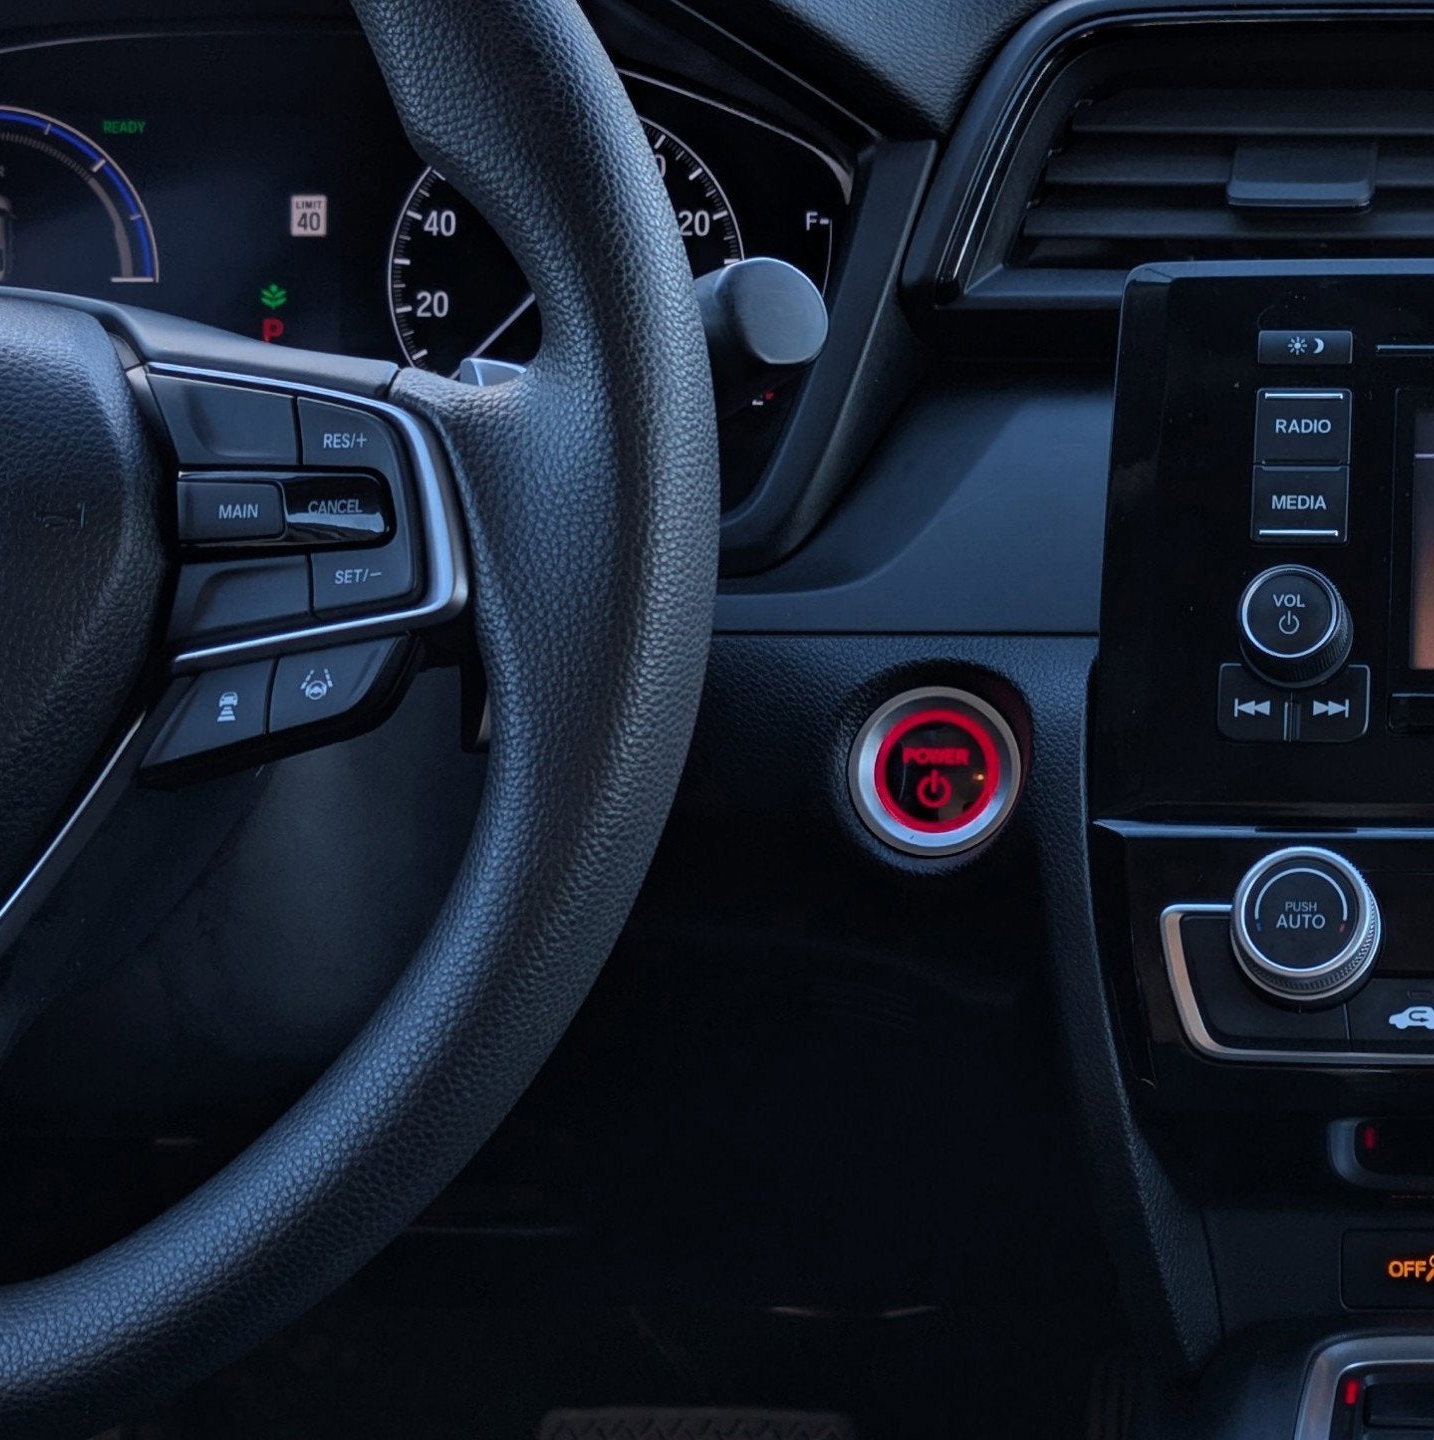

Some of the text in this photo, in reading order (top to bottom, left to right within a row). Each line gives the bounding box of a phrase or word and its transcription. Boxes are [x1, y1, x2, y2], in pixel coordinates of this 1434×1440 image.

[103, 120, 146, 134] READY
[295, 200, 322, 209] LIMIT
[297, 212, 321, 231] 40
[423, 210, 456, 236] 40
[677, 210, 710, 236] 20
[806, 211, 818, 231] F
[416, 290, 449, 318] 20
[1274, 418, 1332, 435] RADIO
[322, 432, 368, 450] RES/+
[218, 503, 259, 520] MAIN
[307, 497, 364, 515] CANCEL
[1271, 494, 1327, 511] MEDIA
[1273, 594, 1306, 609] VOL
[902, 746, 970, 766] POWER
[1284, 901, 1318, 912] PUSH
[1275, 913, 1326, 931] AUTO
[1388, 1260, 1427, 1278] OFF
